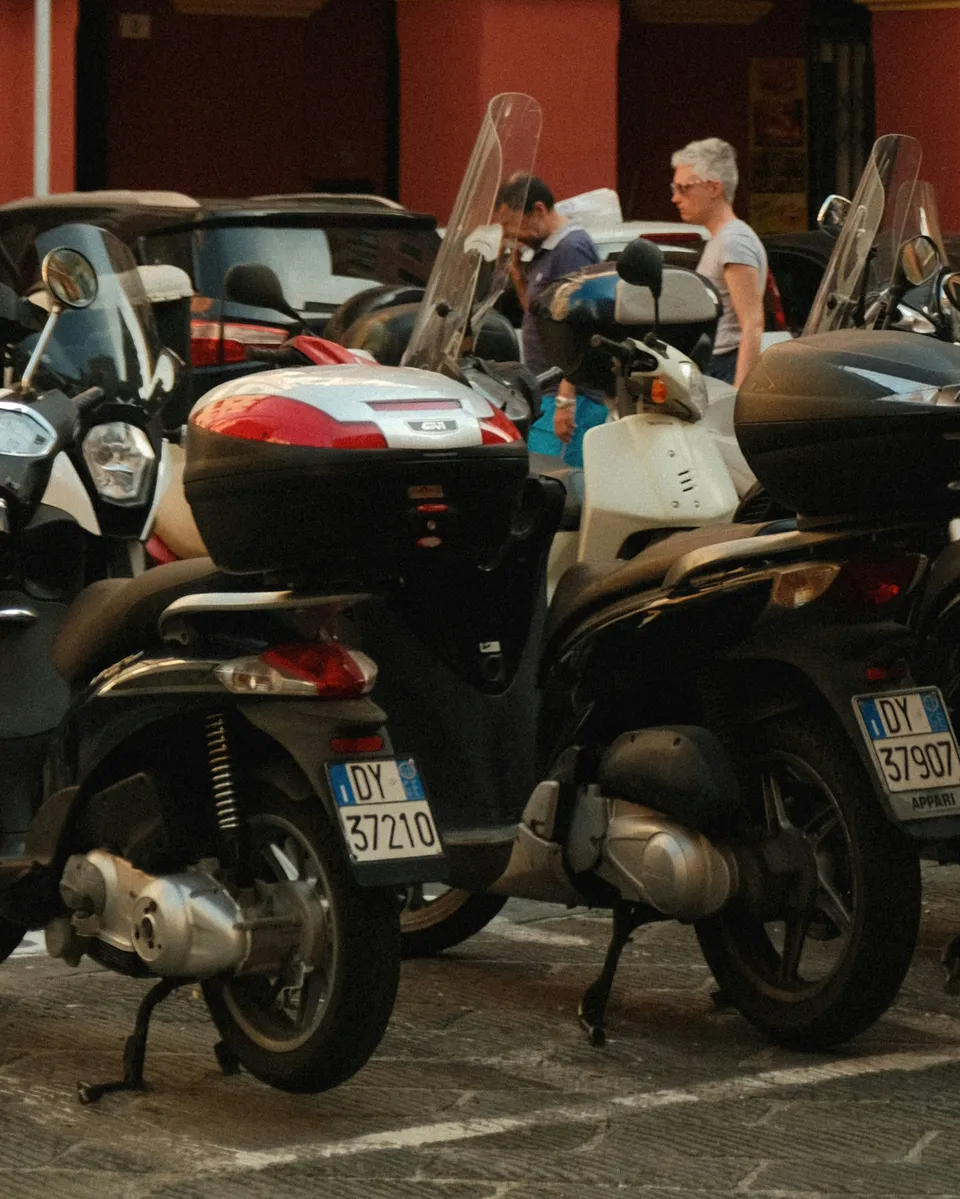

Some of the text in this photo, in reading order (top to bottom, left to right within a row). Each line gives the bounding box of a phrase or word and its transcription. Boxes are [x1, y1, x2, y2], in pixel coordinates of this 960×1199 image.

[880, 697, 912, 734] DY
[879, 741, 952, 782] 37907
[350, 764, 385, 800] DY
[912, 793, 956, 810] APPARI
[346, 811, 435, 851] 37210
